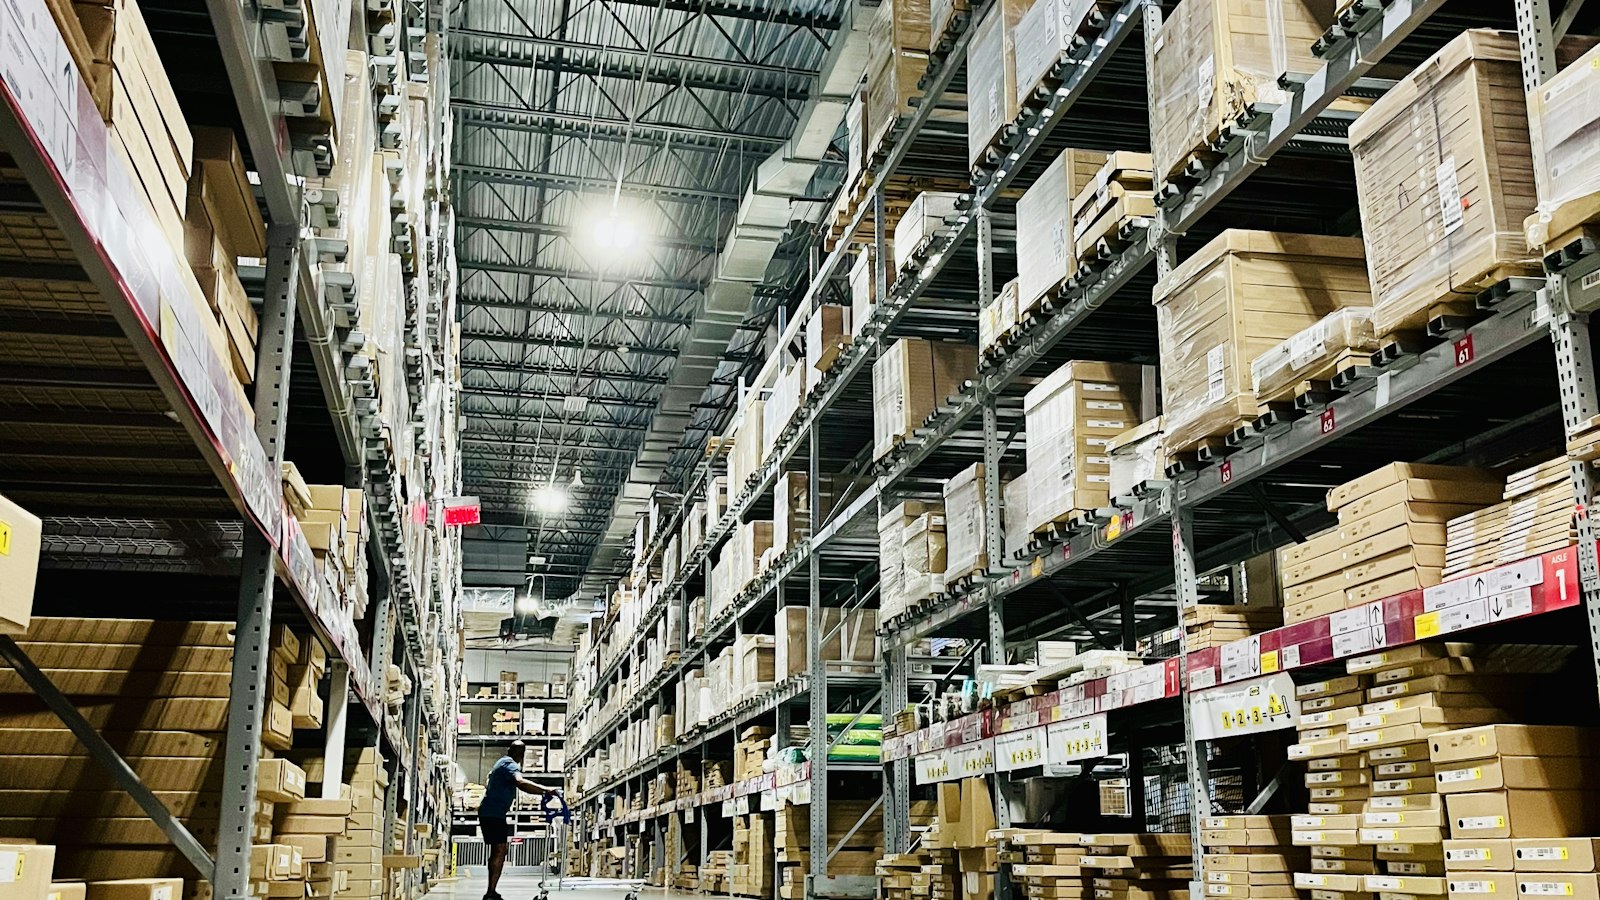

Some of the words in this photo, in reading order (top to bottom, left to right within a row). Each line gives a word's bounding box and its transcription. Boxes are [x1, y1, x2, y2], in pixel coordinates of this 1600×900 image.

[1458, 348, 1469, 364] 61
[1324, 418, 1333, 432] 62
[4, 530, 7, 548] 1
[1552, 552, 1568, 564] AISLE
[1556, 568, 1567, 600] 1
[1170, 670, 1175, 692] 1
[1224, 716, 1229, 726] 1
[1239, 713, 1244, 724] 2
[1254, 710, 1259, 722] 3
[1076, 742, 1080, 751] 2
[1085, 741, 1088, 749] 3
